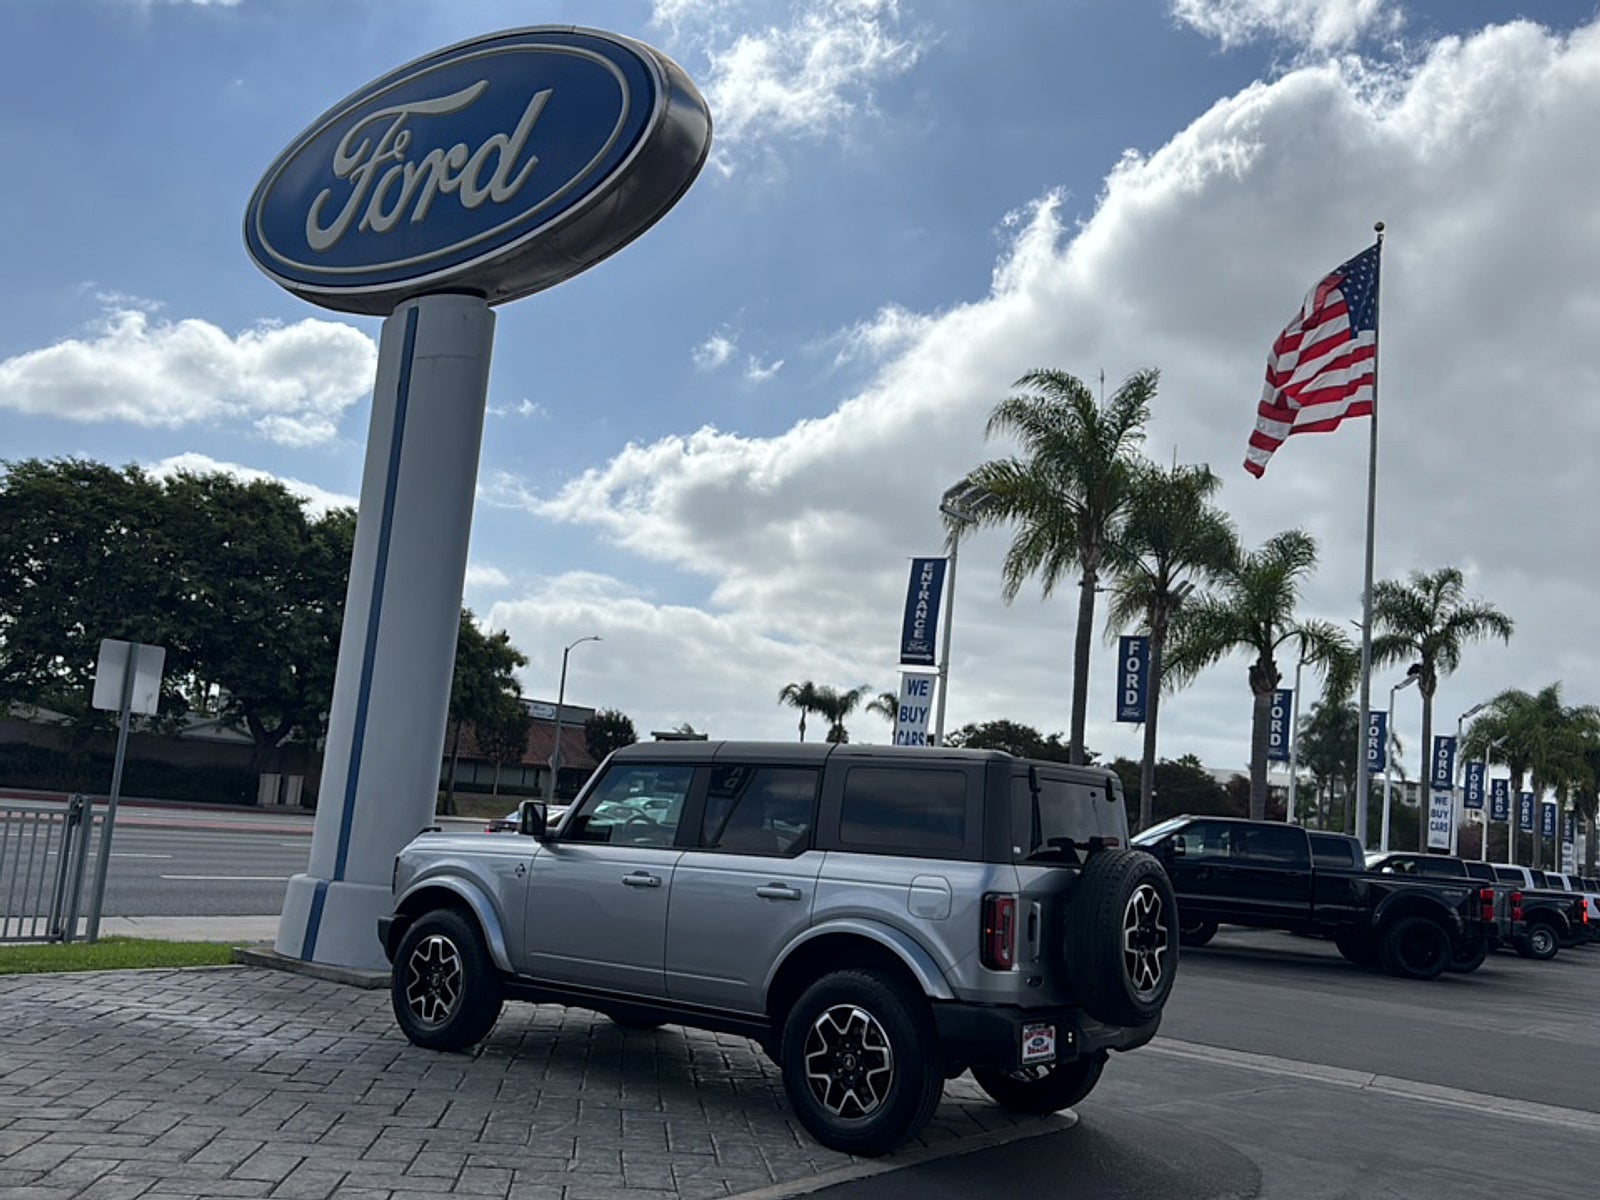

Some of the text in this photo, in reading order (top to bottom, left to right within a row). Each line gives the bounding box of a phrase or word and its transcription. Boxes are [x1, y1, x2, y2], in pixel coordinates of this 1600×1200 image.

[306, 80, 553, 252] Ford
[913, 562, 934, 639] ENTRANCE
[907, 679, 930, 696] WE
[1125, 641, 1140, 705] FORD
[900, 706, 928, 723] BUY
[1270, 692, 1284, 746] FORD
[897, 730, 925, 746] CARS
[1368, 714, 1380, 760] FORD
[1437, 739, 1449, 779] FORD
[1469, 765, 1479, 800] FORD
[1495, 781, 1504, 812] FORD
[1430, 809, 1449, 819] BUY
[1434, 796, 1448, 806] WE
[1521, 794, 1530, 822] FORD
[1430, 821, 1448, 833] CARS
